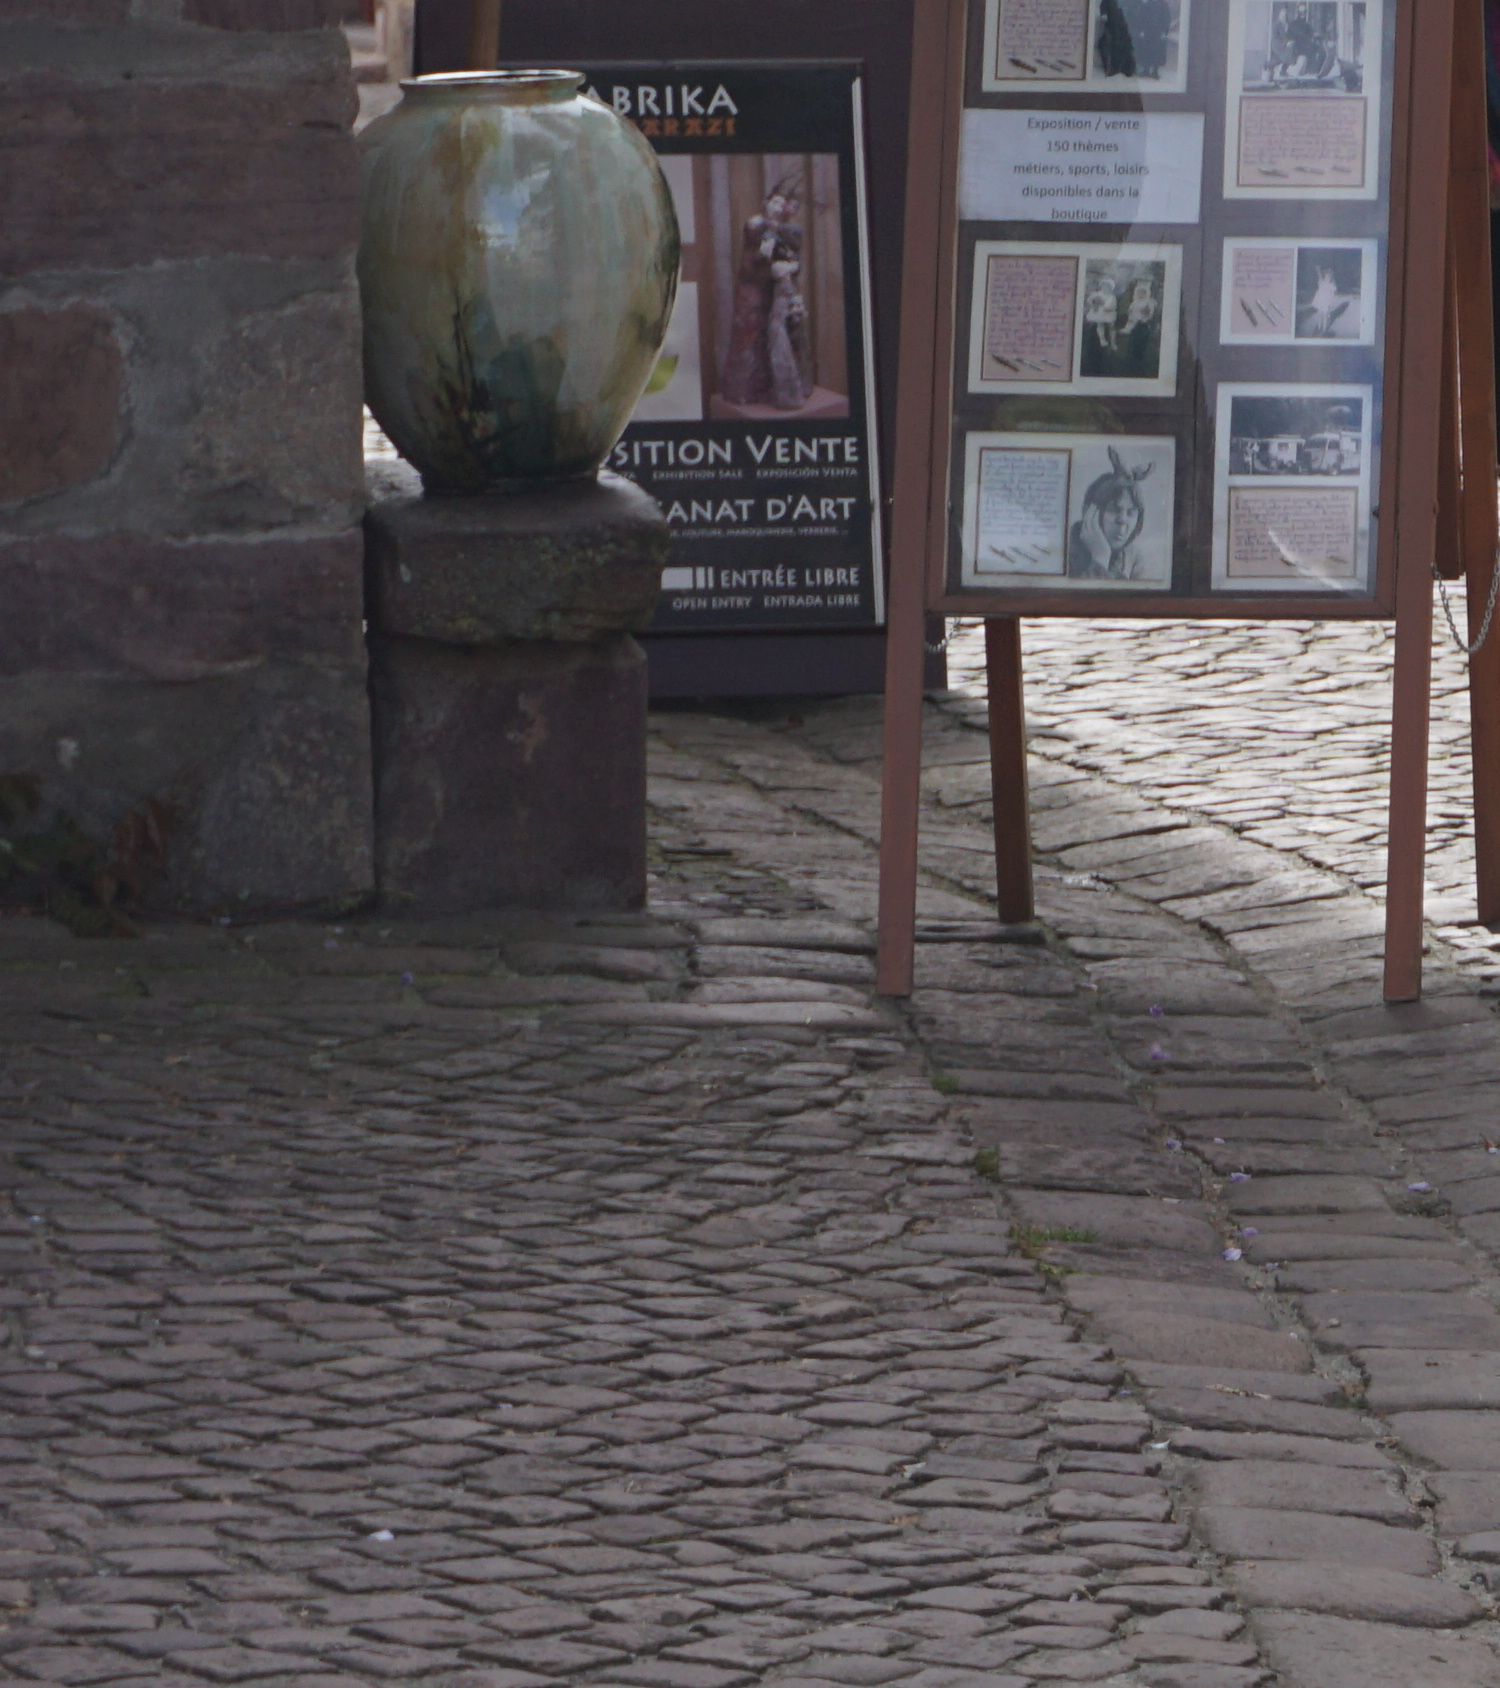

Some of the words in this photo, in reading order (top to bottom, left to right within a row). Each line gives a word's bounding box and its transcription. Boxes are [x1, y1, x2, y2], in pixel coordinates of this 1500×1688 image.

[1028, 117, 1091, 131] Exposition
[1094, 117, 1101, 131] /
[1105, 119, 1140, 130] vente
[1046, 140, 1069, 152] 150
[1073, 140, 1119, 152] thèmes
[1013, 162, 1064, 176] métiers,
[1068, 164, 1110, 177] sports,
[1114, 162, 1150, 176] loisirs
[1021, 184, 1092, 199] disponibles
[1096, 185, 1125, 197] dans
[1129, 185, 1139, 197] la
[1051, 207, 1108, 223] boutique
[602, 438, 732, 467] SITION
[719, 468, 743, 480] SALE
[822, 466, 859, 478] VENTA
[658, 498, 755, 524] ANAT
[720, 563, 797, 589] ENTRÉE
[805, 565, 861, 588] LIBRE
[672, 596, 707, 611] OPEN
[711, 596, 753, 610] ENTRY
[763, 594, 823, 609] ENTRADA
[827, 593, 861, 607] LIBRE
